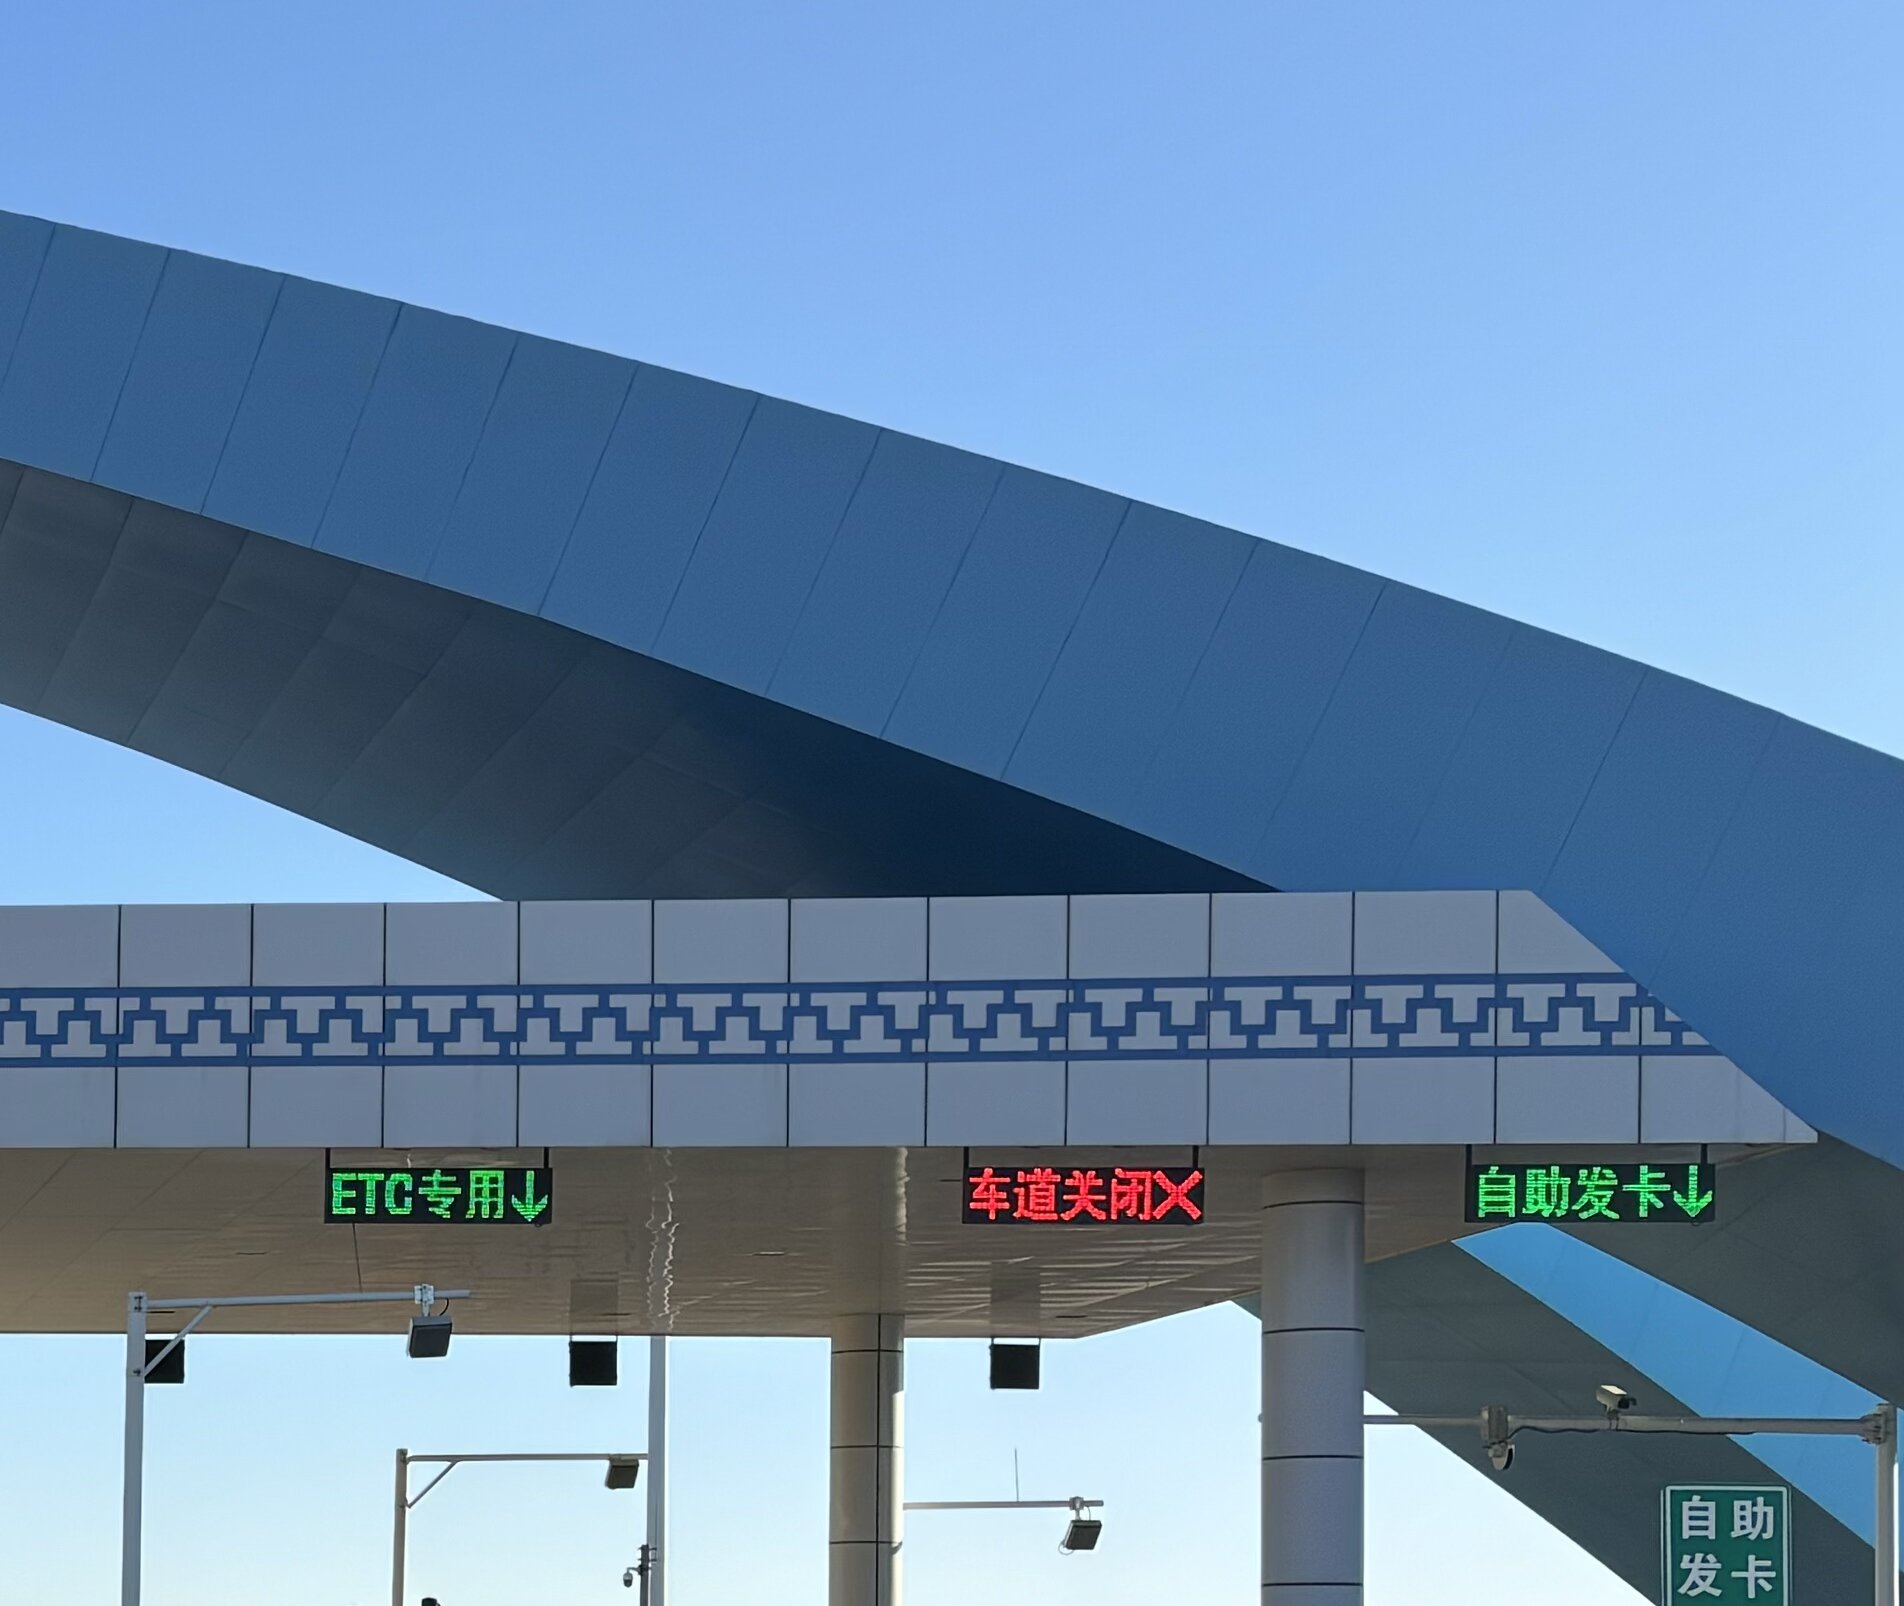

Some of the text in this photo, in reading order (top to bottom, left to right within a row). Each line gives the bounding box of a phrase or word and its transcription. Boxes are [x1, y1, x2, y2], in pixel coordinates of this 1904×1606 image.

[332, 1169, 504, 1218] ETC专用
[969, 1168, 1153, 1220] 车道关闭
[1478, 1166, 1671, 1219] 自助发卡
[1681, 1495, 1774, 1540] 自助
[1678, 1553, 1777, 1598] 发卡
